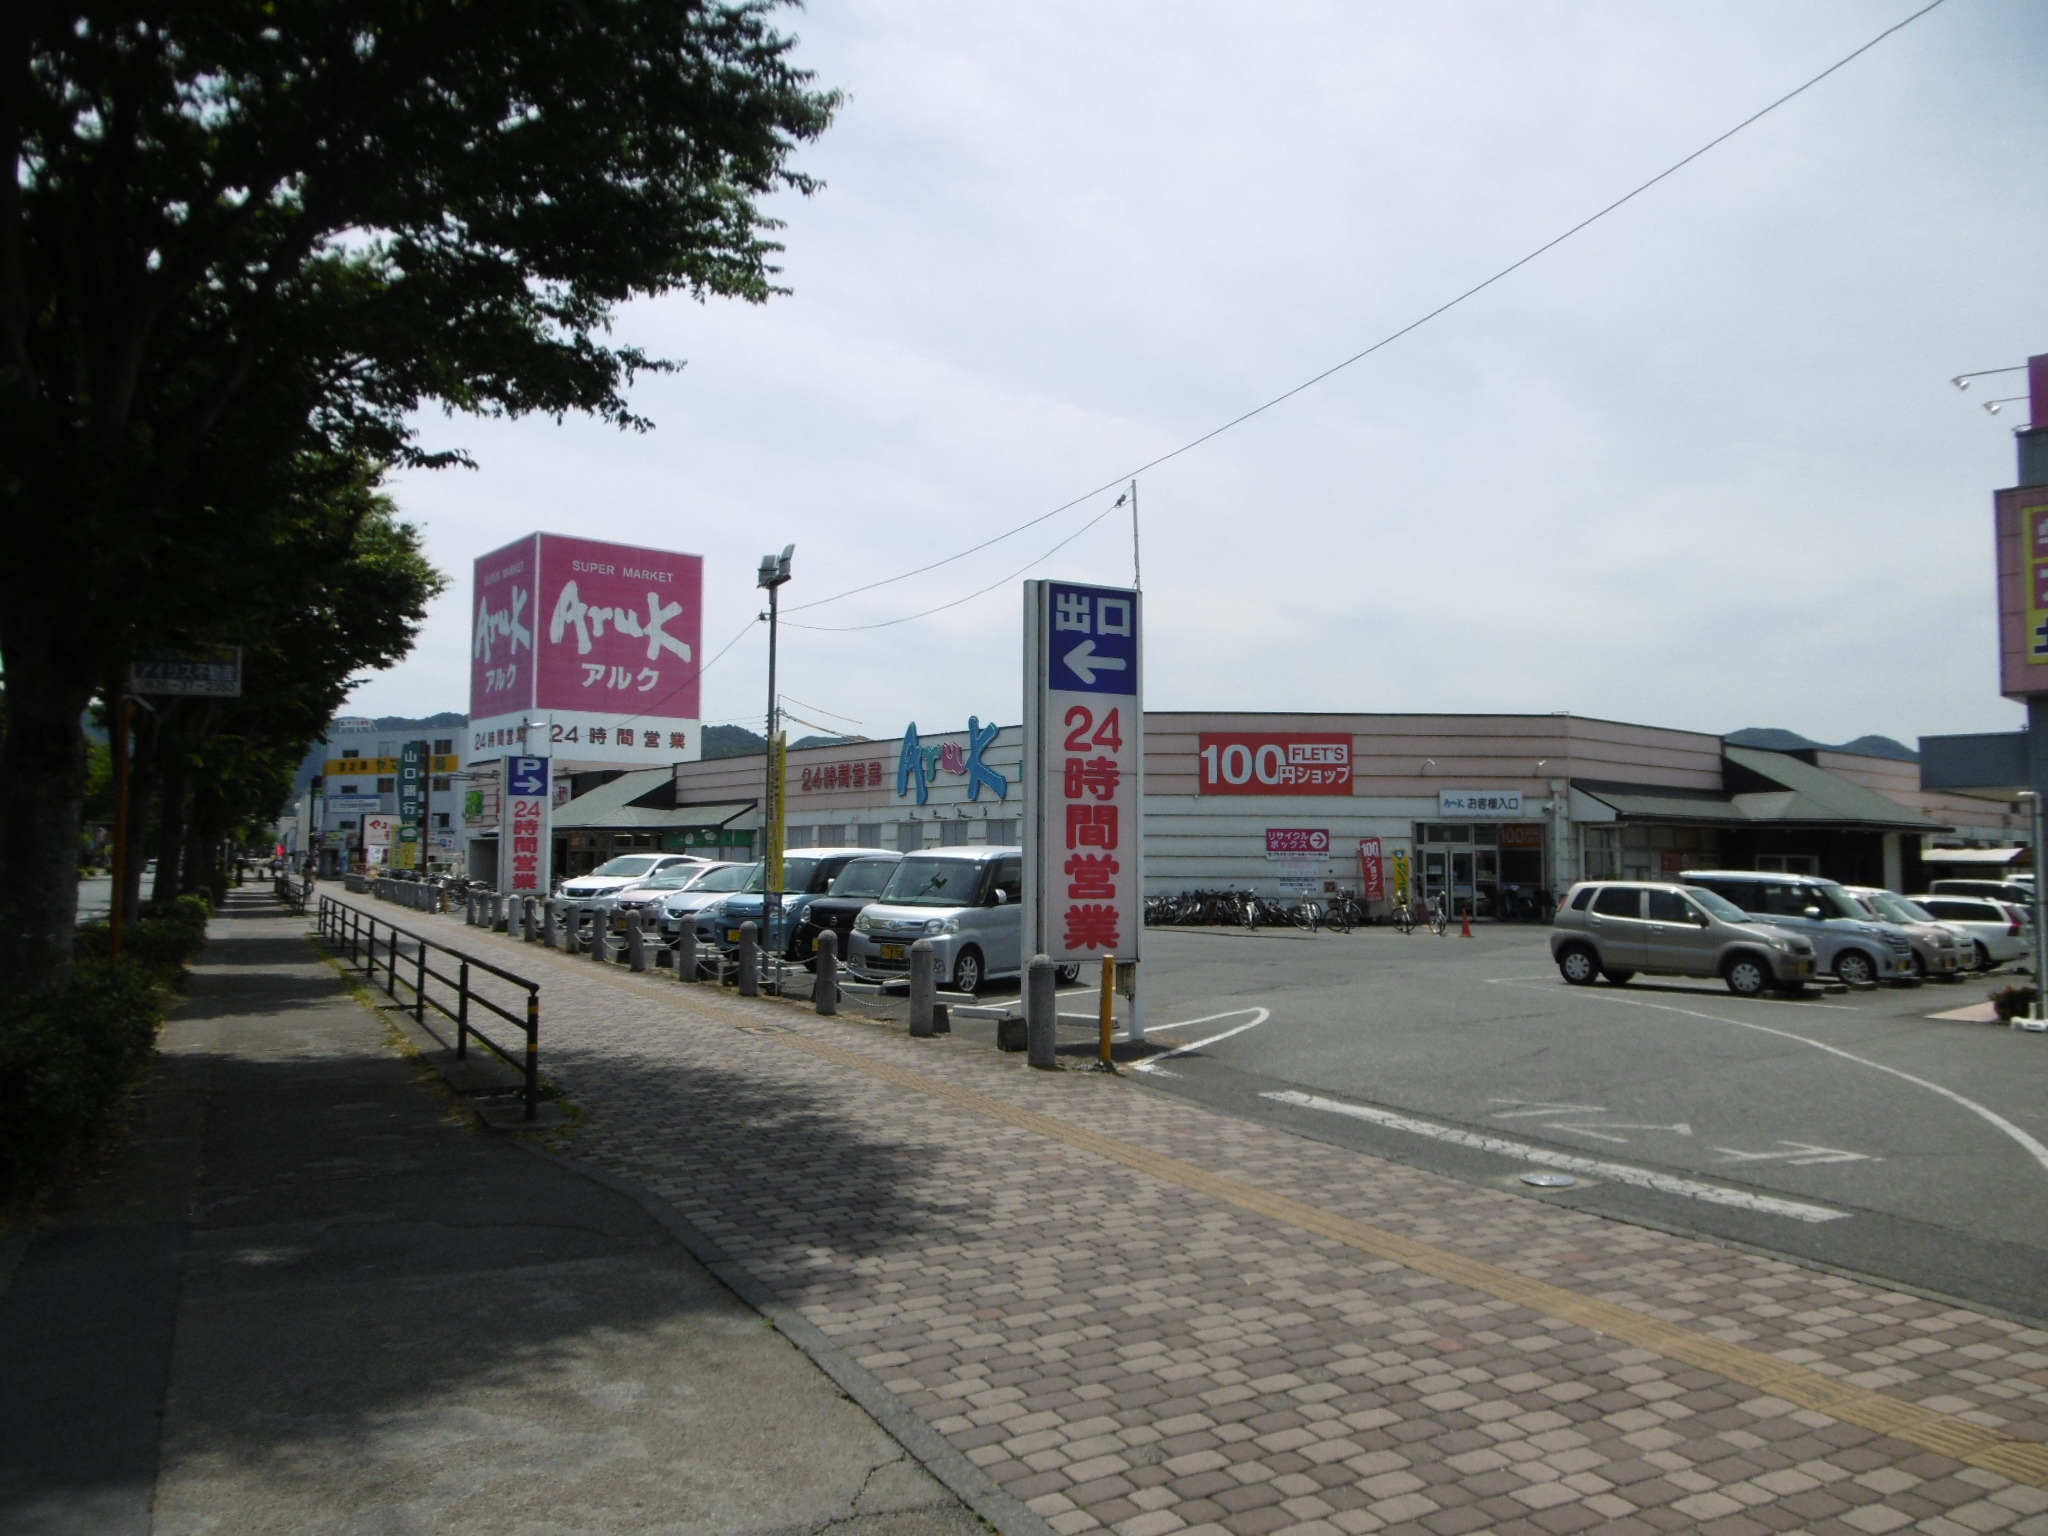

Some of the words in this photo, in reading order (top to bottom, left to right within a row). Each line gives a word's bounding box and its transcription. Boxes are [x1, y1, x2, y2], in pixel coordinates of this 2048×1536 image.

[572, 560, 615, 576] SUPER
[623, 567, 674, 583] MARKET
[1055, 592, 1131, 638] 出口
[485, 663, 517, 694] アルク
[581, 662, 660, 692] アルク
[550, 723, 687, 750] 24時間営業
[517, 758, 541, 776] P
[1292, 747, 1345, 761] FLET'S
[402, 750, 418, 815] 山口銀行
[801, 762, 882, 791] 24時間営業
[1467, 797, 1518, 810] お客様入口
[1063, 705, 1123, 950] 24時間営業
[1268, 831, 1310, 841] リサイクル
[513, 800, 541, 890] 24時間営業
[1270, 840, 1308, 849] ボックス
